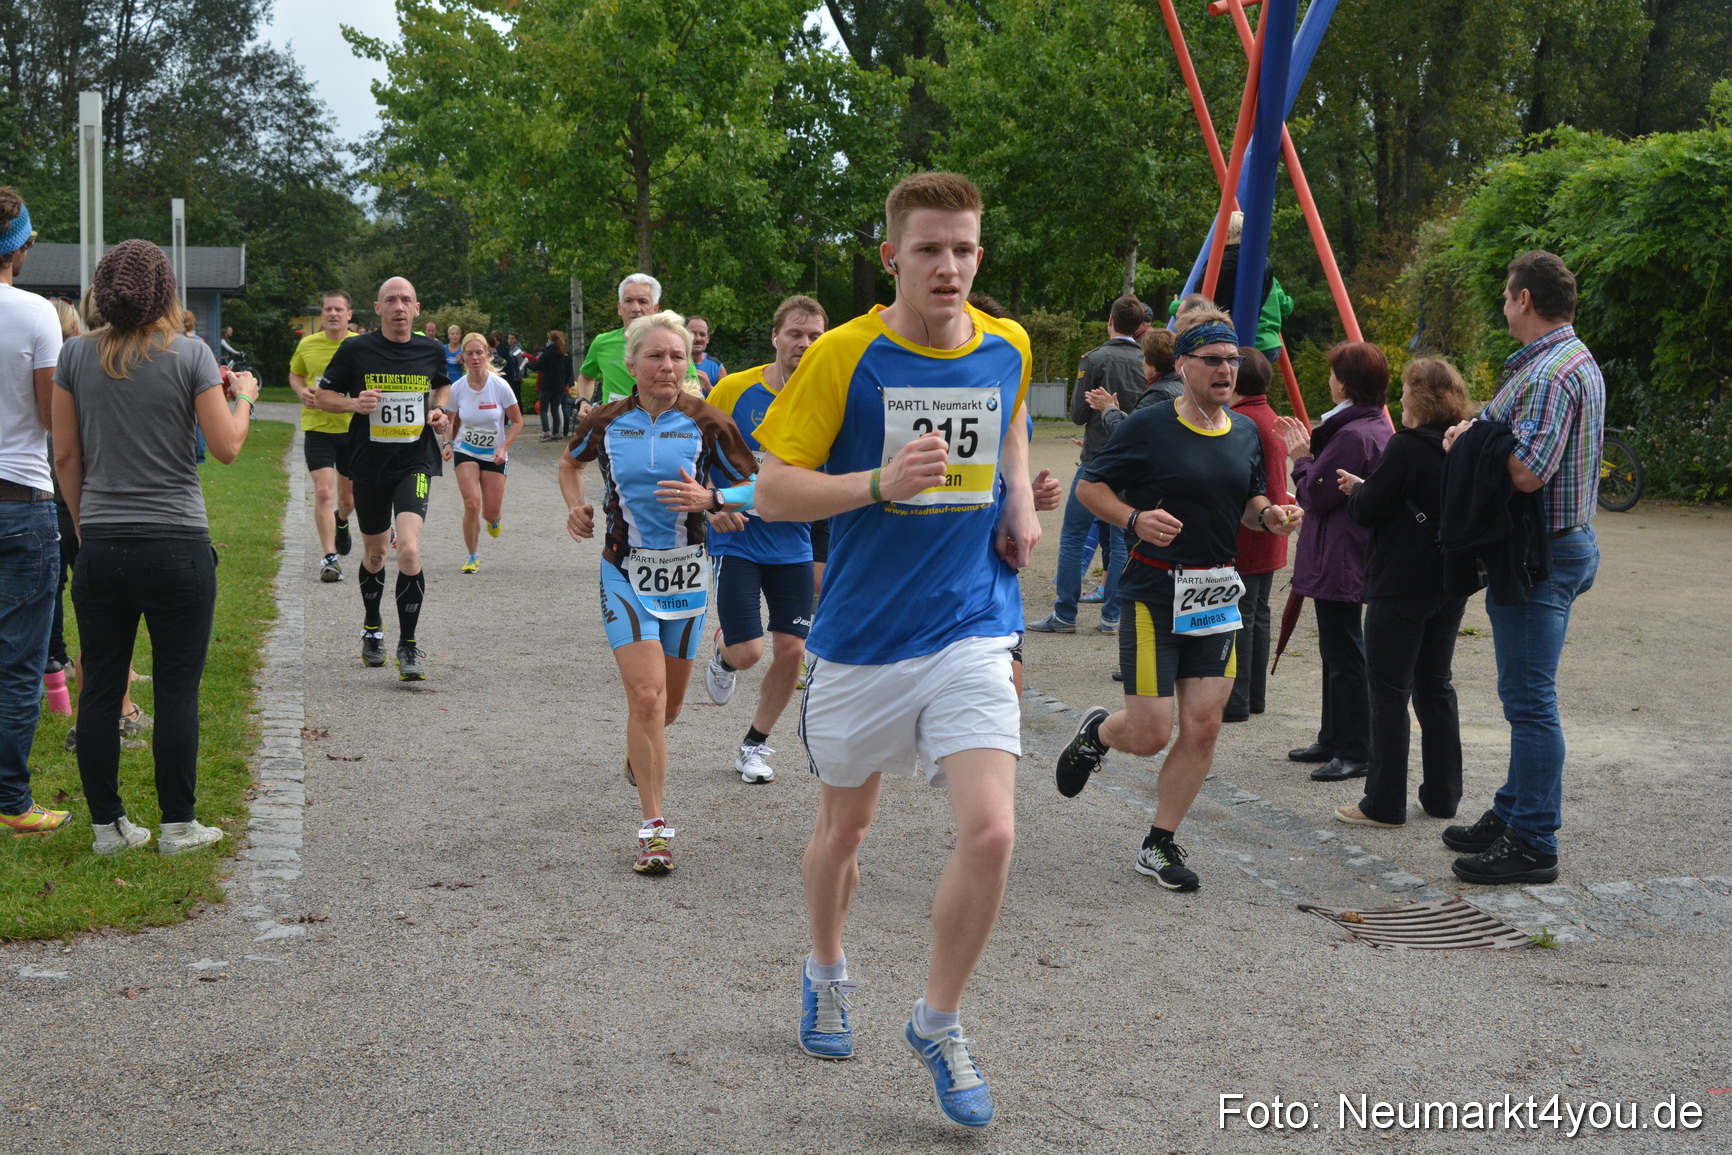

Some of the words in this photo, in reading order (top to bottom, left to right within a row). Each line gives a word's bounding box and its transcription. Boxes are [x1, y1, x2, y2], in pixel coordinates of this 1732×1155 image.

[887, 400, 930, 411] PARTL
[932, 400, 983, 411] Neumarkt
[381, 404, 415, 424] 615
[464, 431, 495, 447] 3322
[630, 554, 658, 564] PARTL
[658, 553, 694, 565] Neumarkt
[636, 561, 702, 593] 2642
[1177, 577, 1204, 585] PARTL
[652, 597, 689, 610] Marion
[1180, 583, 1241, 612] 2429
[1190, 612, 1227, 628] Andreas
